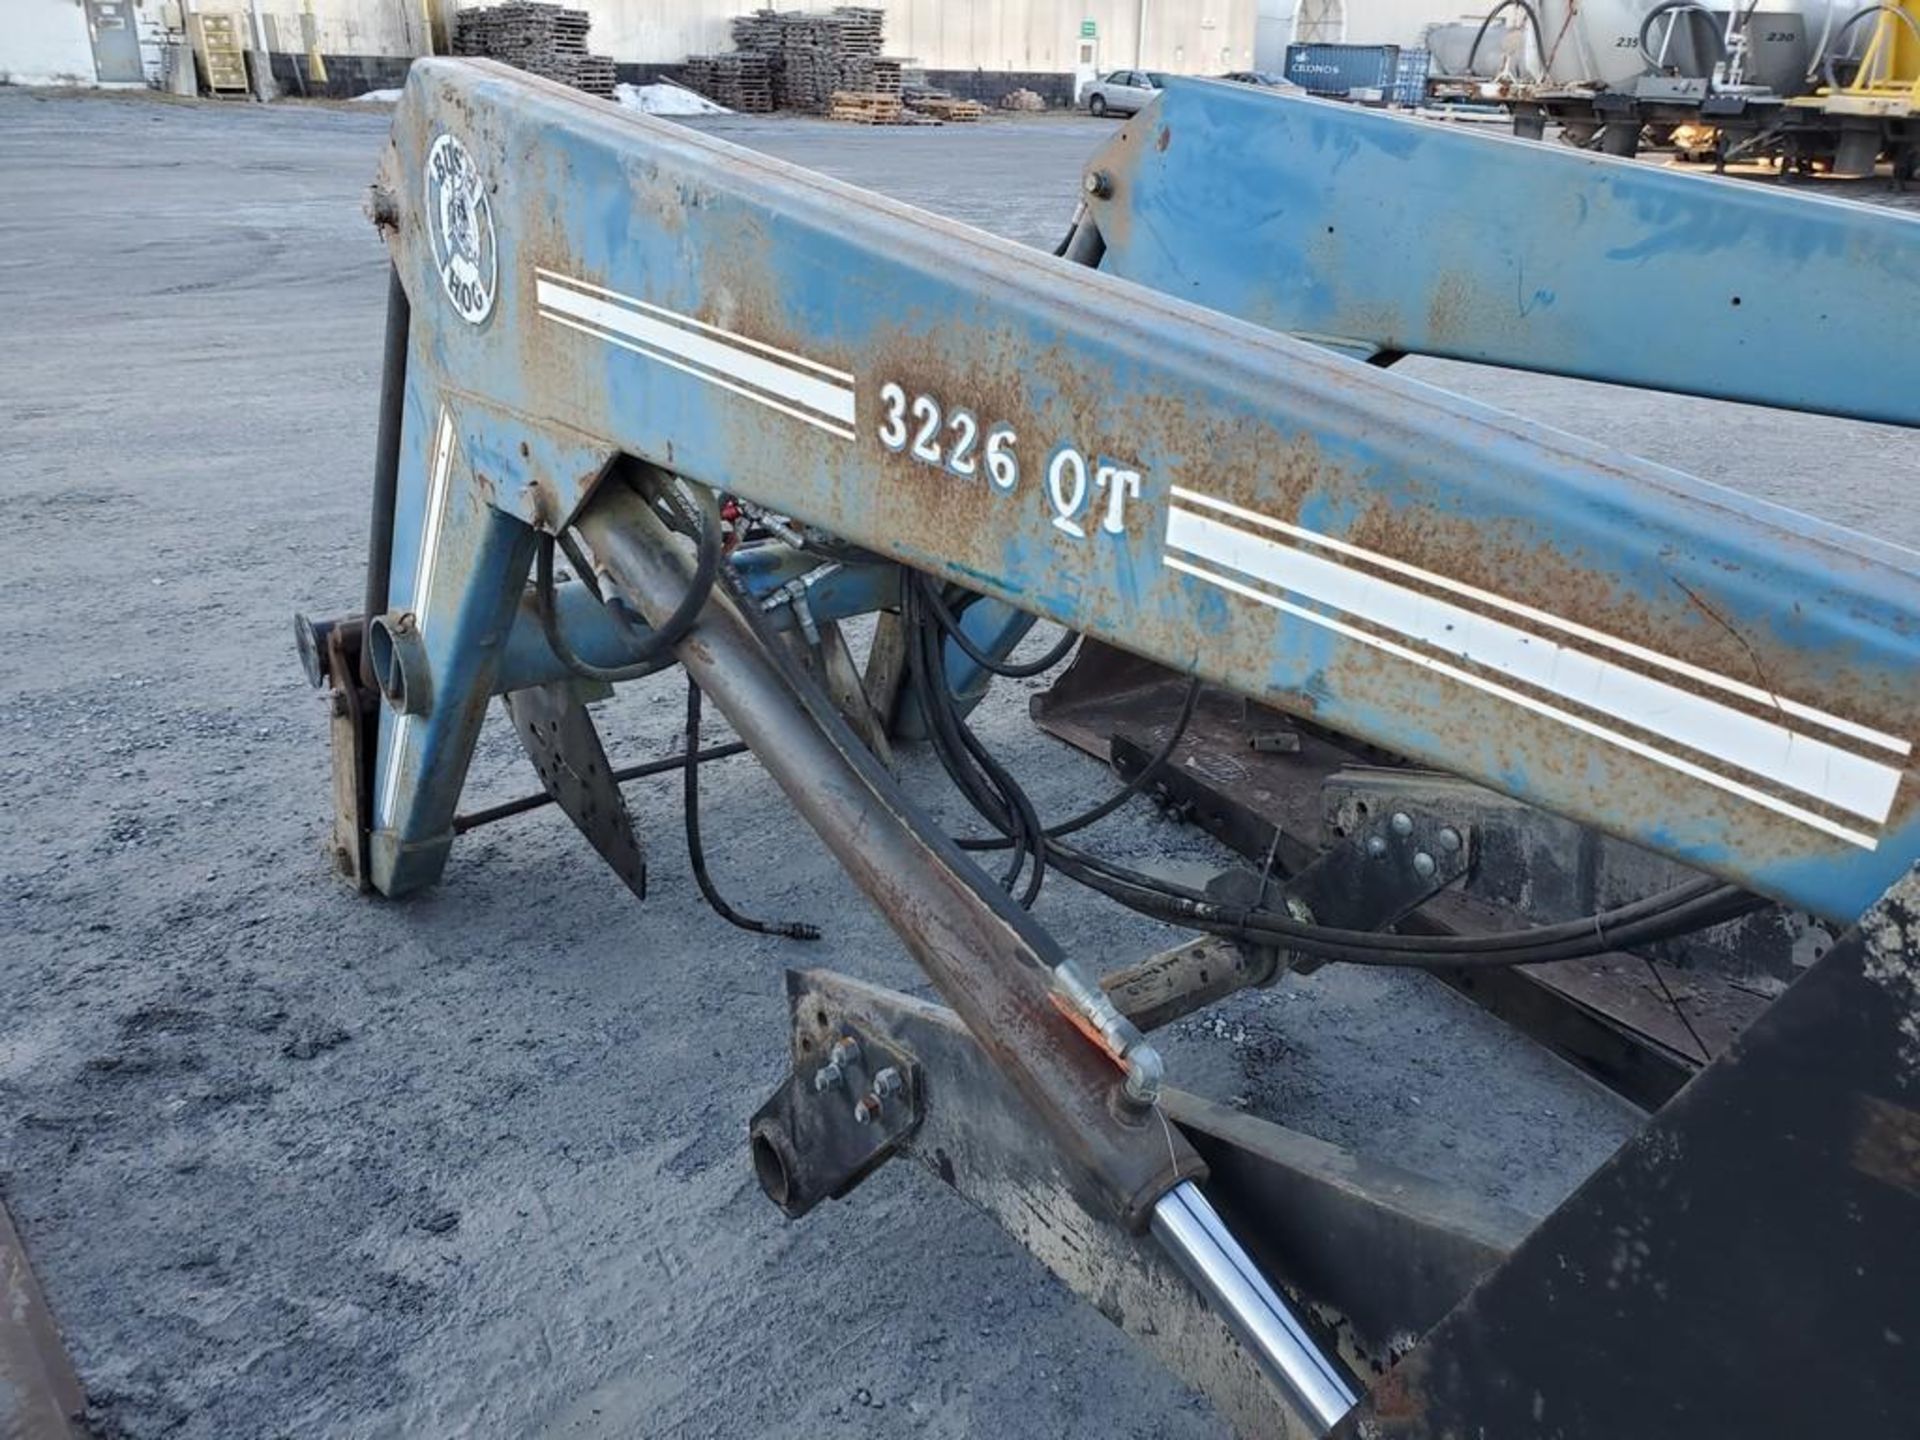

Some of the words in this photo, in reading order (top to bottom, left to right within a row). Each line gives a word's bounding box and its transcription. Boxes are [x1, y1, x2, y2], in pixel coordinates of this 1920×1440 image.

[448, 267, 483, 313] HOG
[879, 382, 1017, 488] 3226
[1049, 448, 1140, 538] QT
